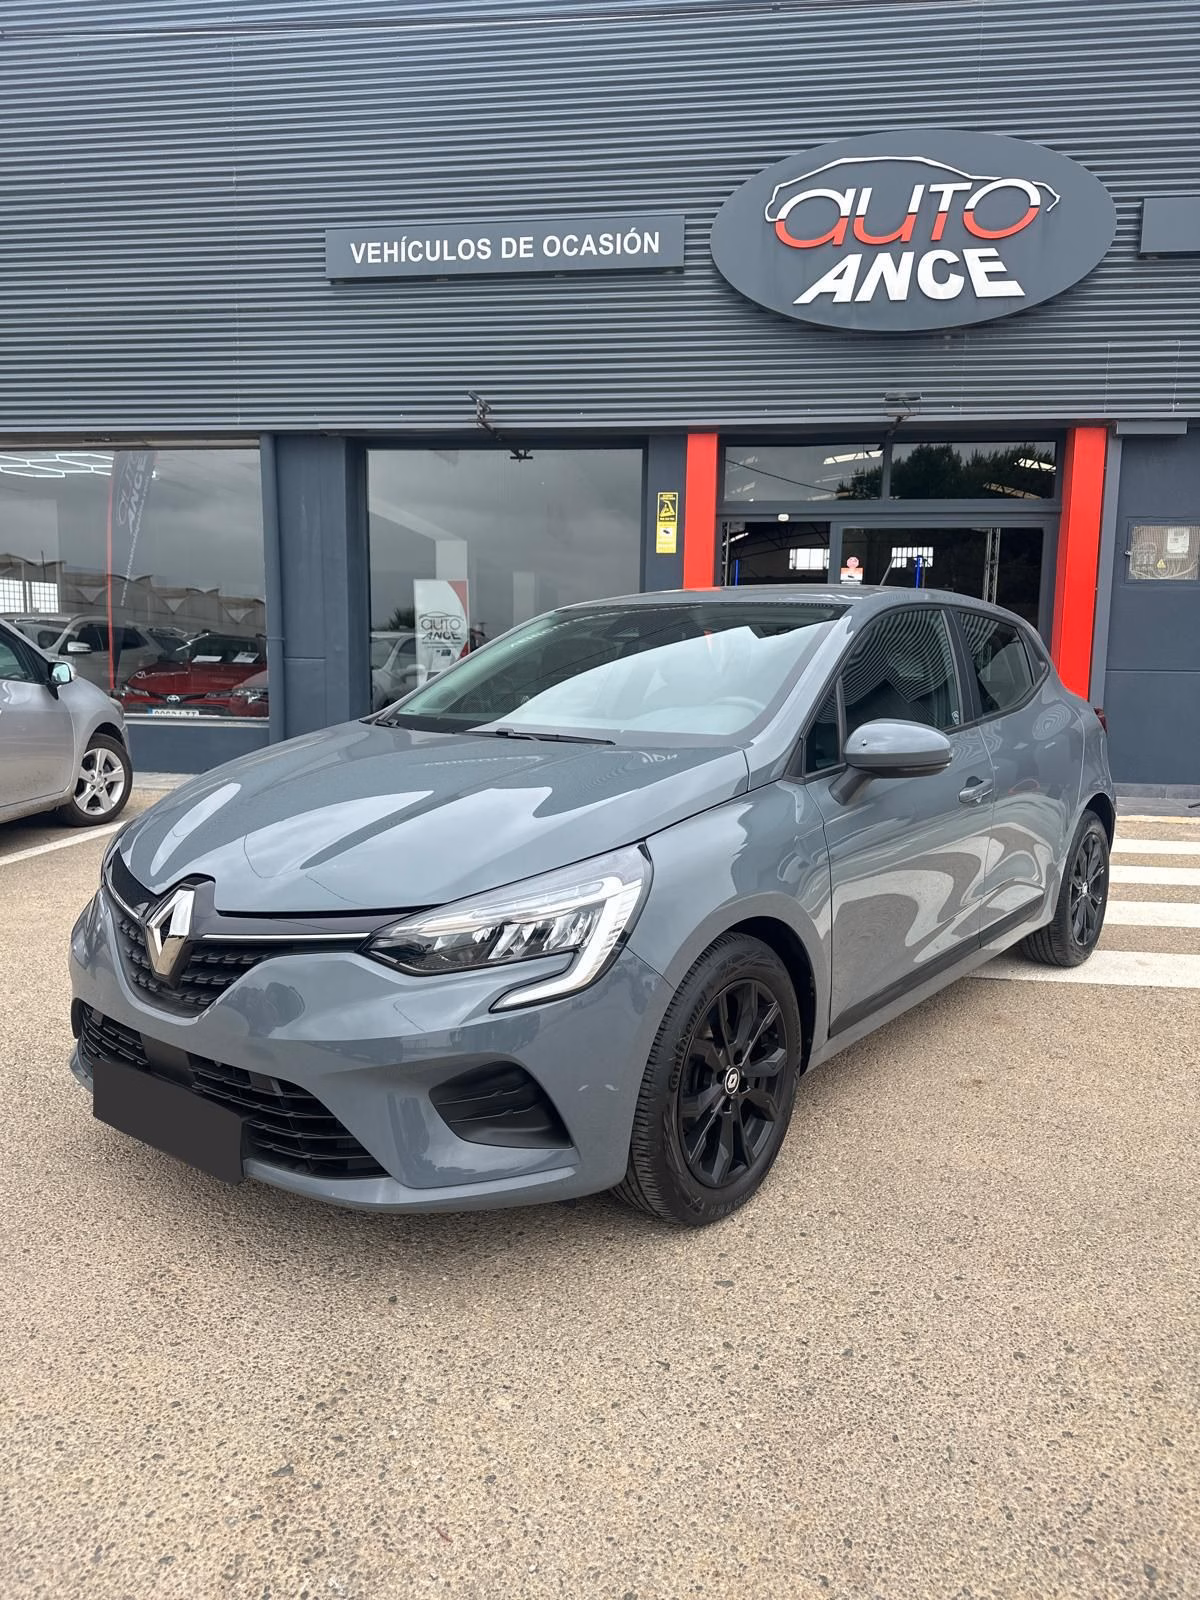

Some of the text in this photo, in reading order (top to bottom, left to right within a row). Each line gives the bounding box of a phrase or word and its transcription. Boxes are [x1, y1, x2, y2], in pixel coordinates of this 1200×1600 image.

[350, 227, 660, 264] VEHÍCULOS DE OCASIÓN
[792, 247, 1026, 304] ANCE
[421, 631, 462, 640] ANCE
